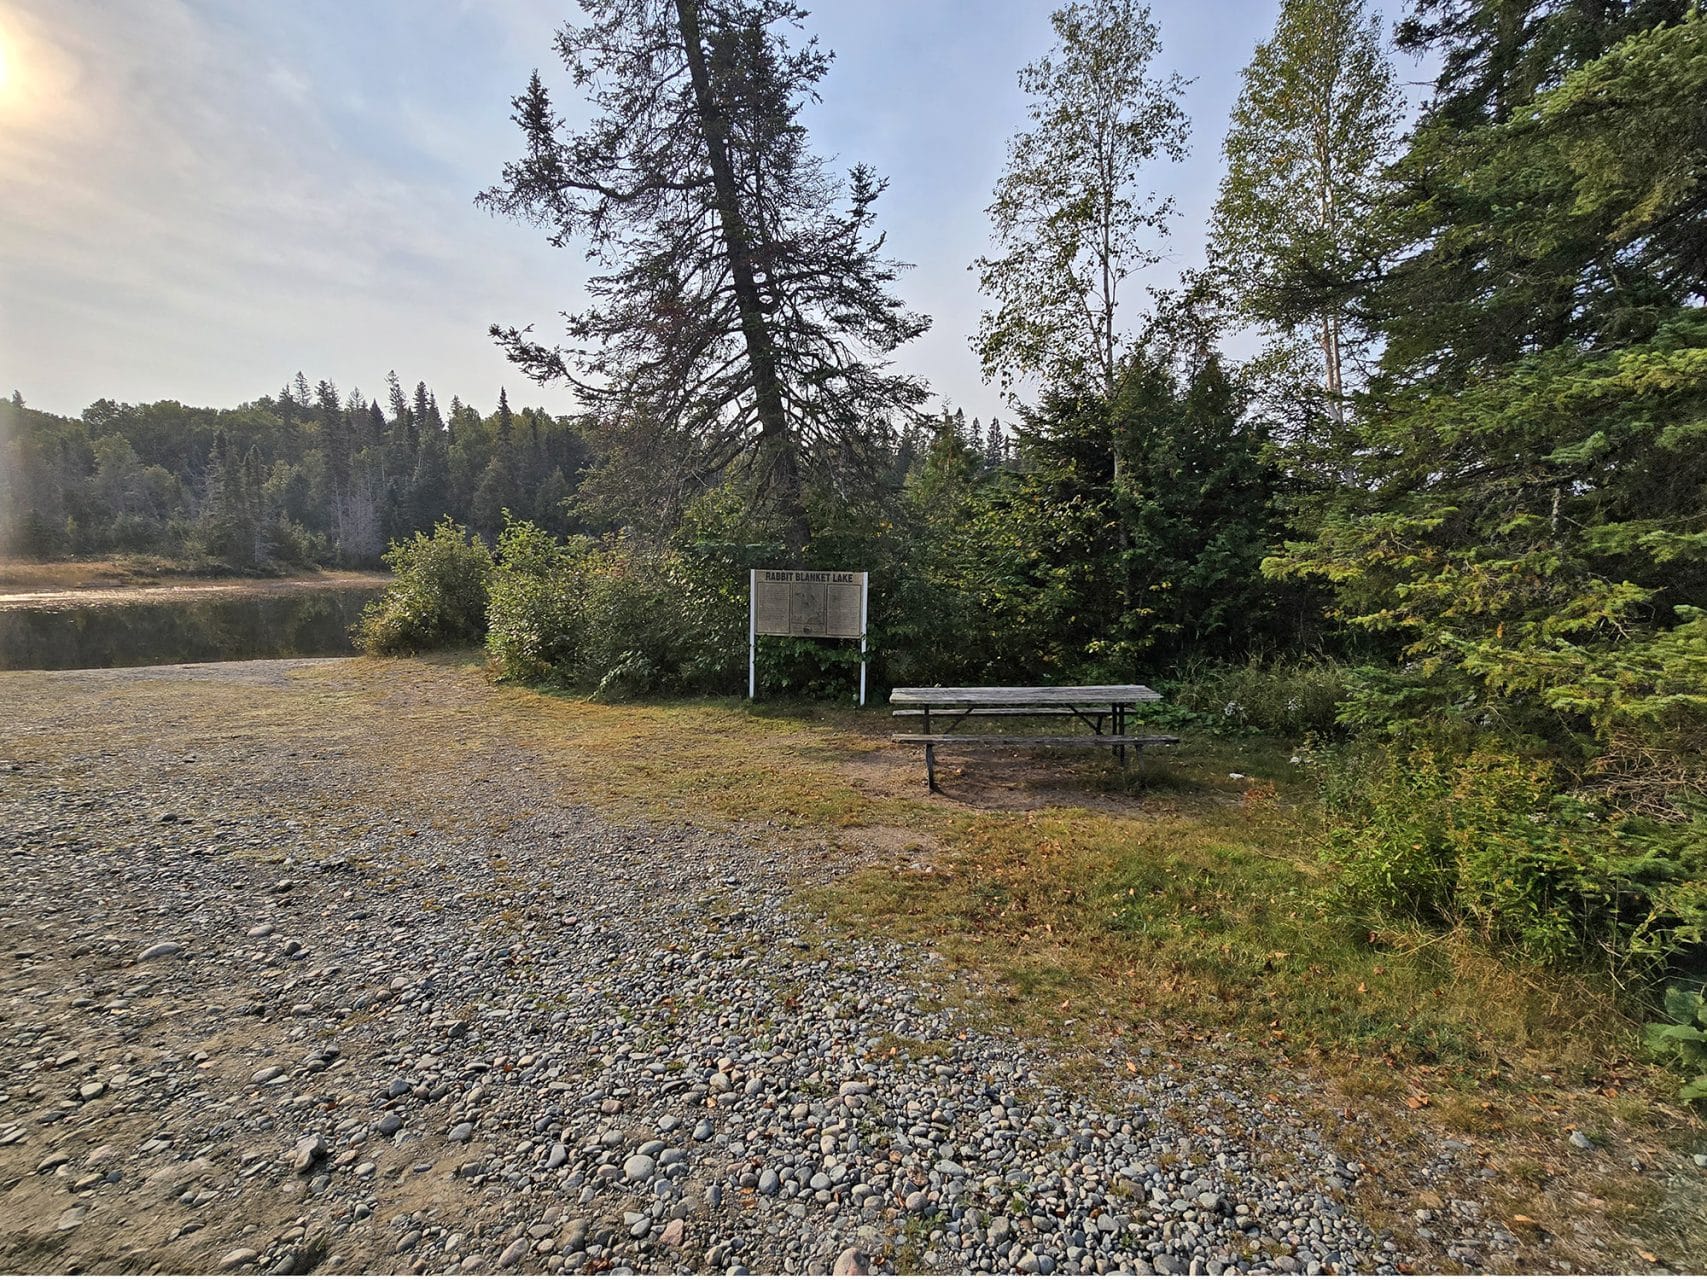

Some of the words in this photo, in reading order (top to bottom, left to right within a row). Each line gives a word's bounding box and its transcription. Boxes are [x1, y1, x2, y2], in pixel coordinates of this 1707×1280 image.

[766, 572, 793, 581] RABBIT
[796, 573, 830, 582] BLANKET
[833, 574, 853, 583] LAKE
